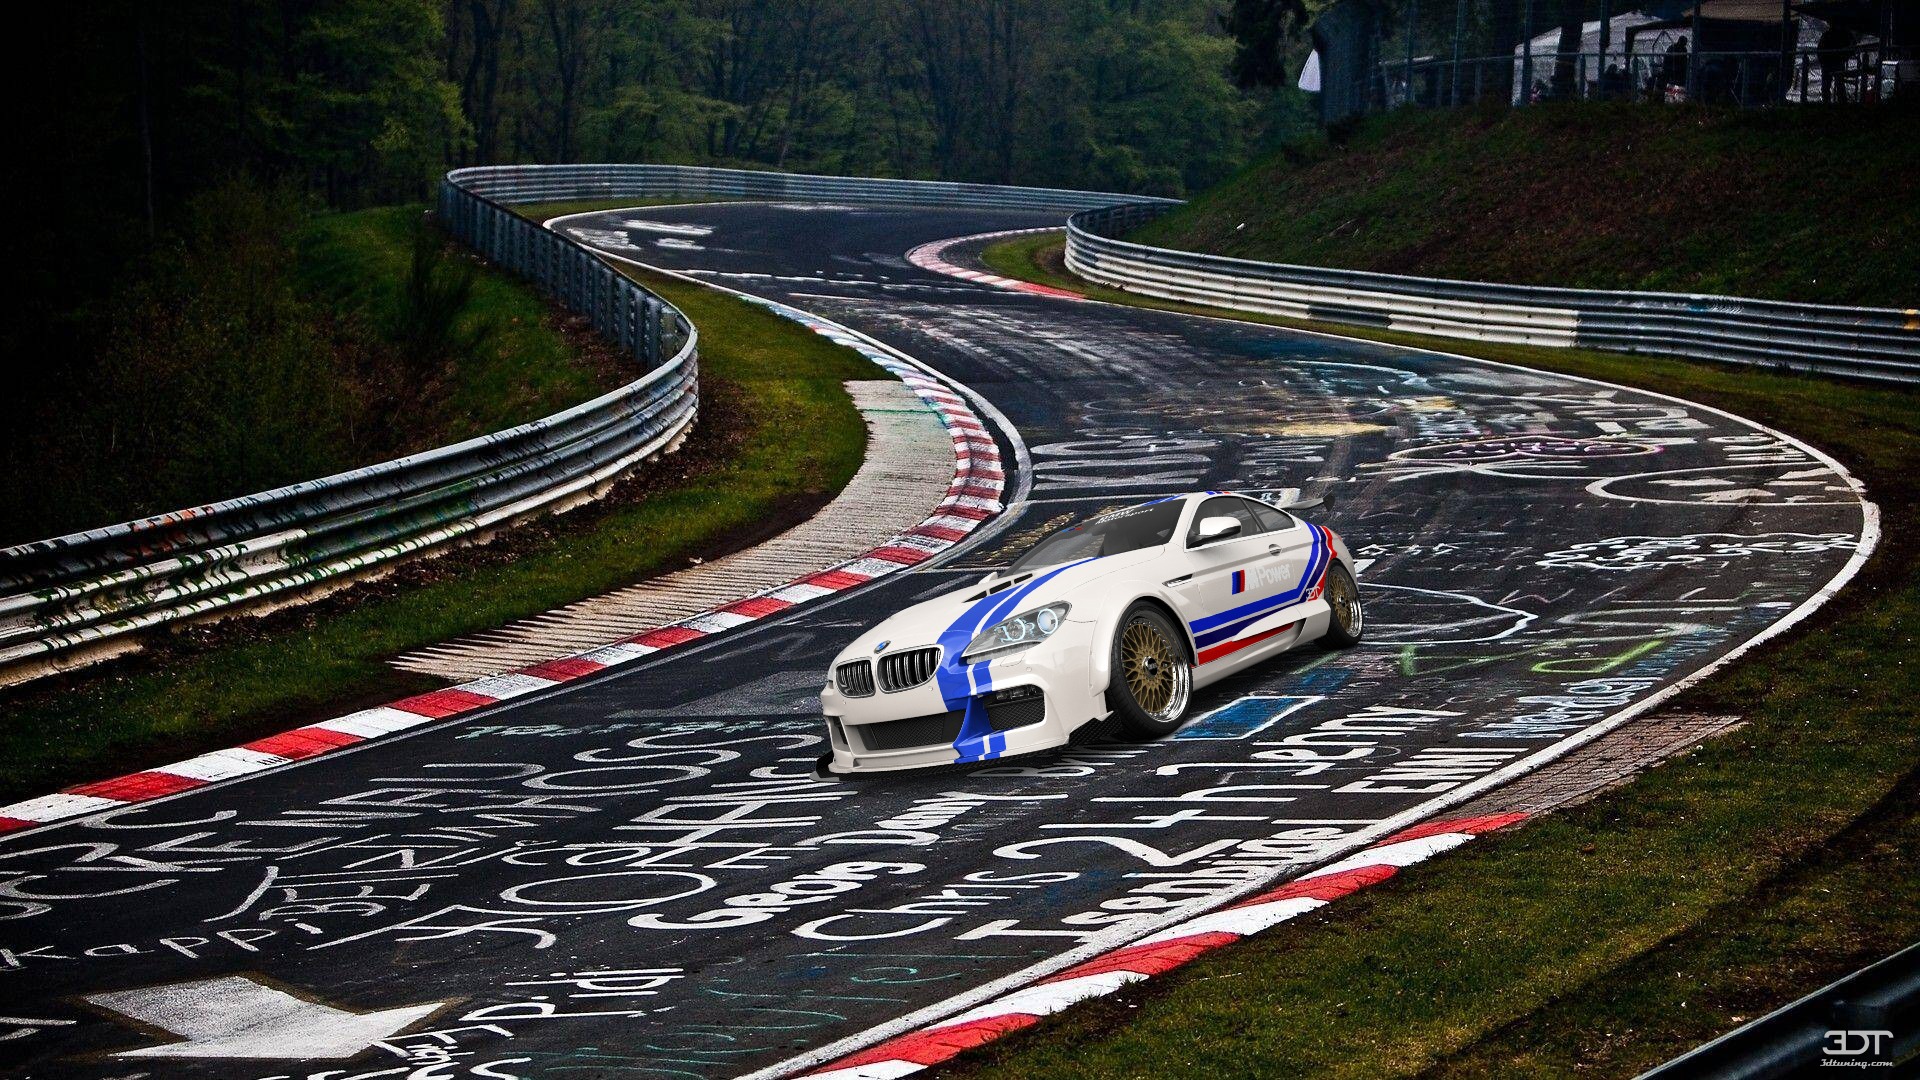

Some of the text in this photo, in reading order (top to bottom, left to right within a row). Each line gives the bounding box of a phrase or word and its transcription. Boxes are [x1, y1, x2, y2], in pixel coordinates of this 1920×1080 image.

[627, 861, 926, 930] Georg
[795, 791, 1069, 847] Danny
[458, 967, 685, 1022] Pidi
